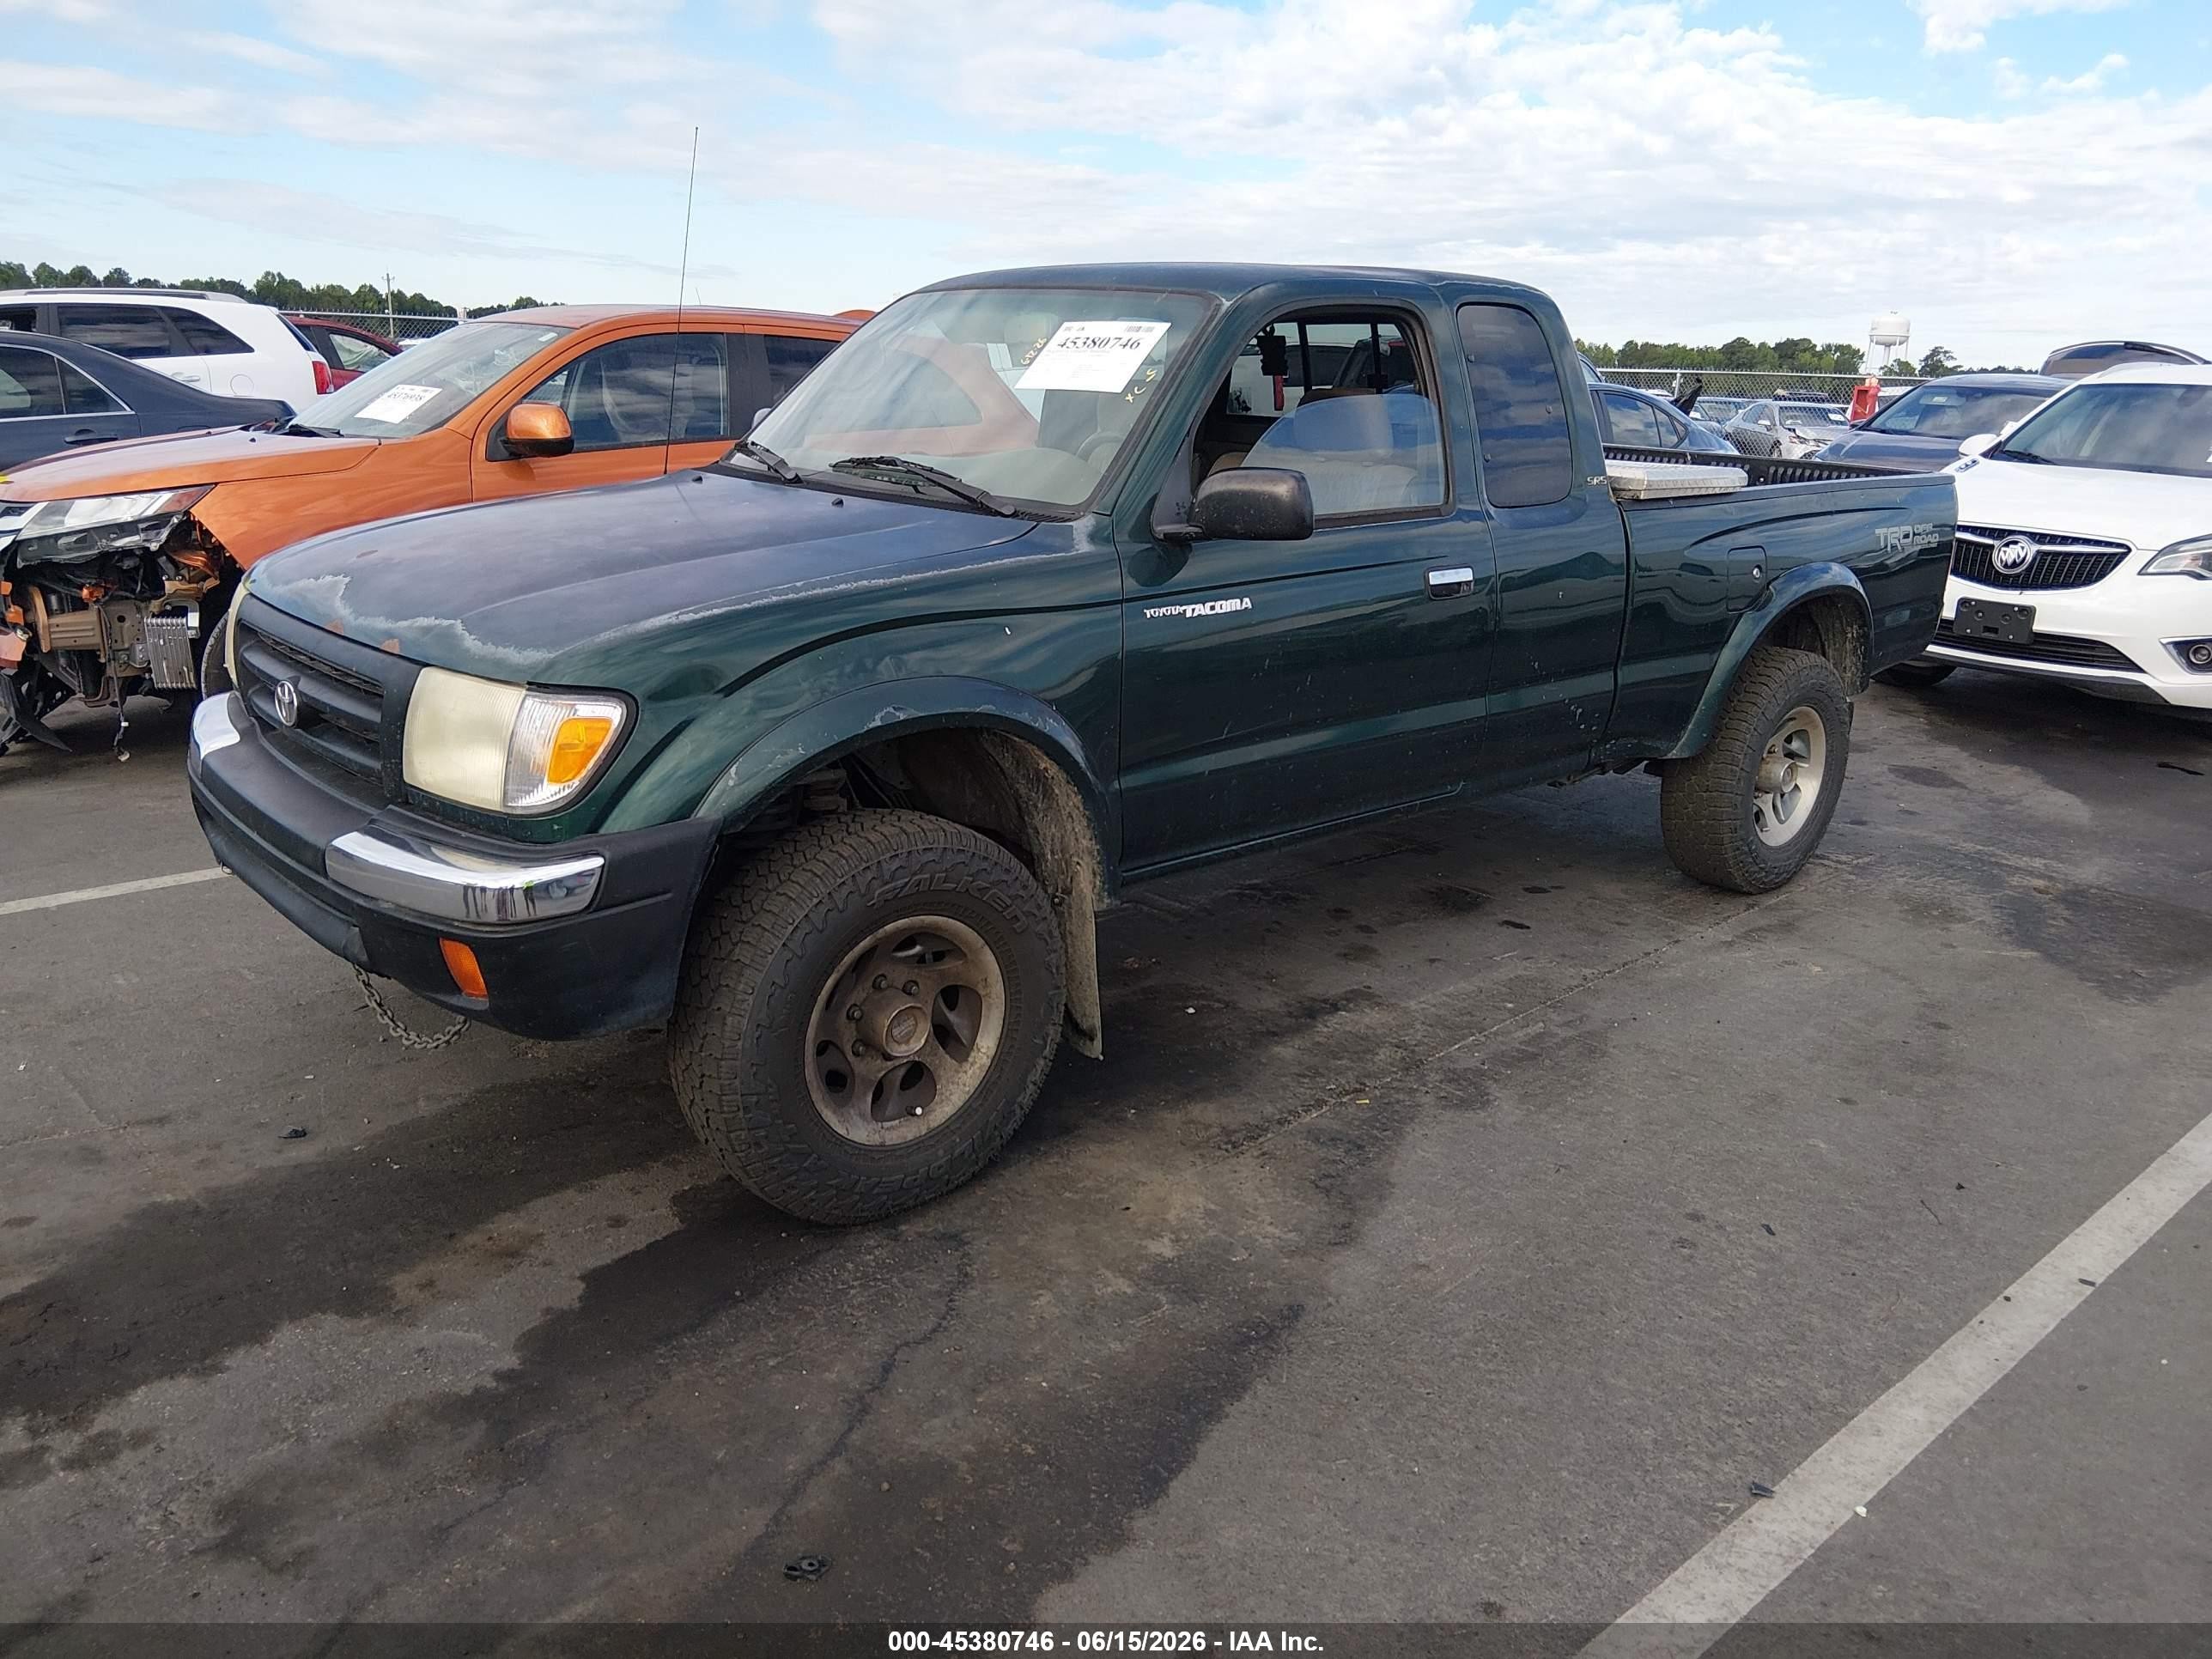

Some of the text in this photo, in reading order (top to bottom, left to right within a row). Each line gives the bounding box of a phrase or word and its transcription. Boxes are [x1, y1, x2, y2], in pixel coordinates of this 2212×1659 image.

[1057, 337, 1144, 349] 45380746
[1586, 475, 1608, 487] SRS
[1875, 526, 1914, 554] TRD
[1913, 533, 1940, 545] ROAD
[1143, 597, 1253, 619] TOYOTA TACOMA
